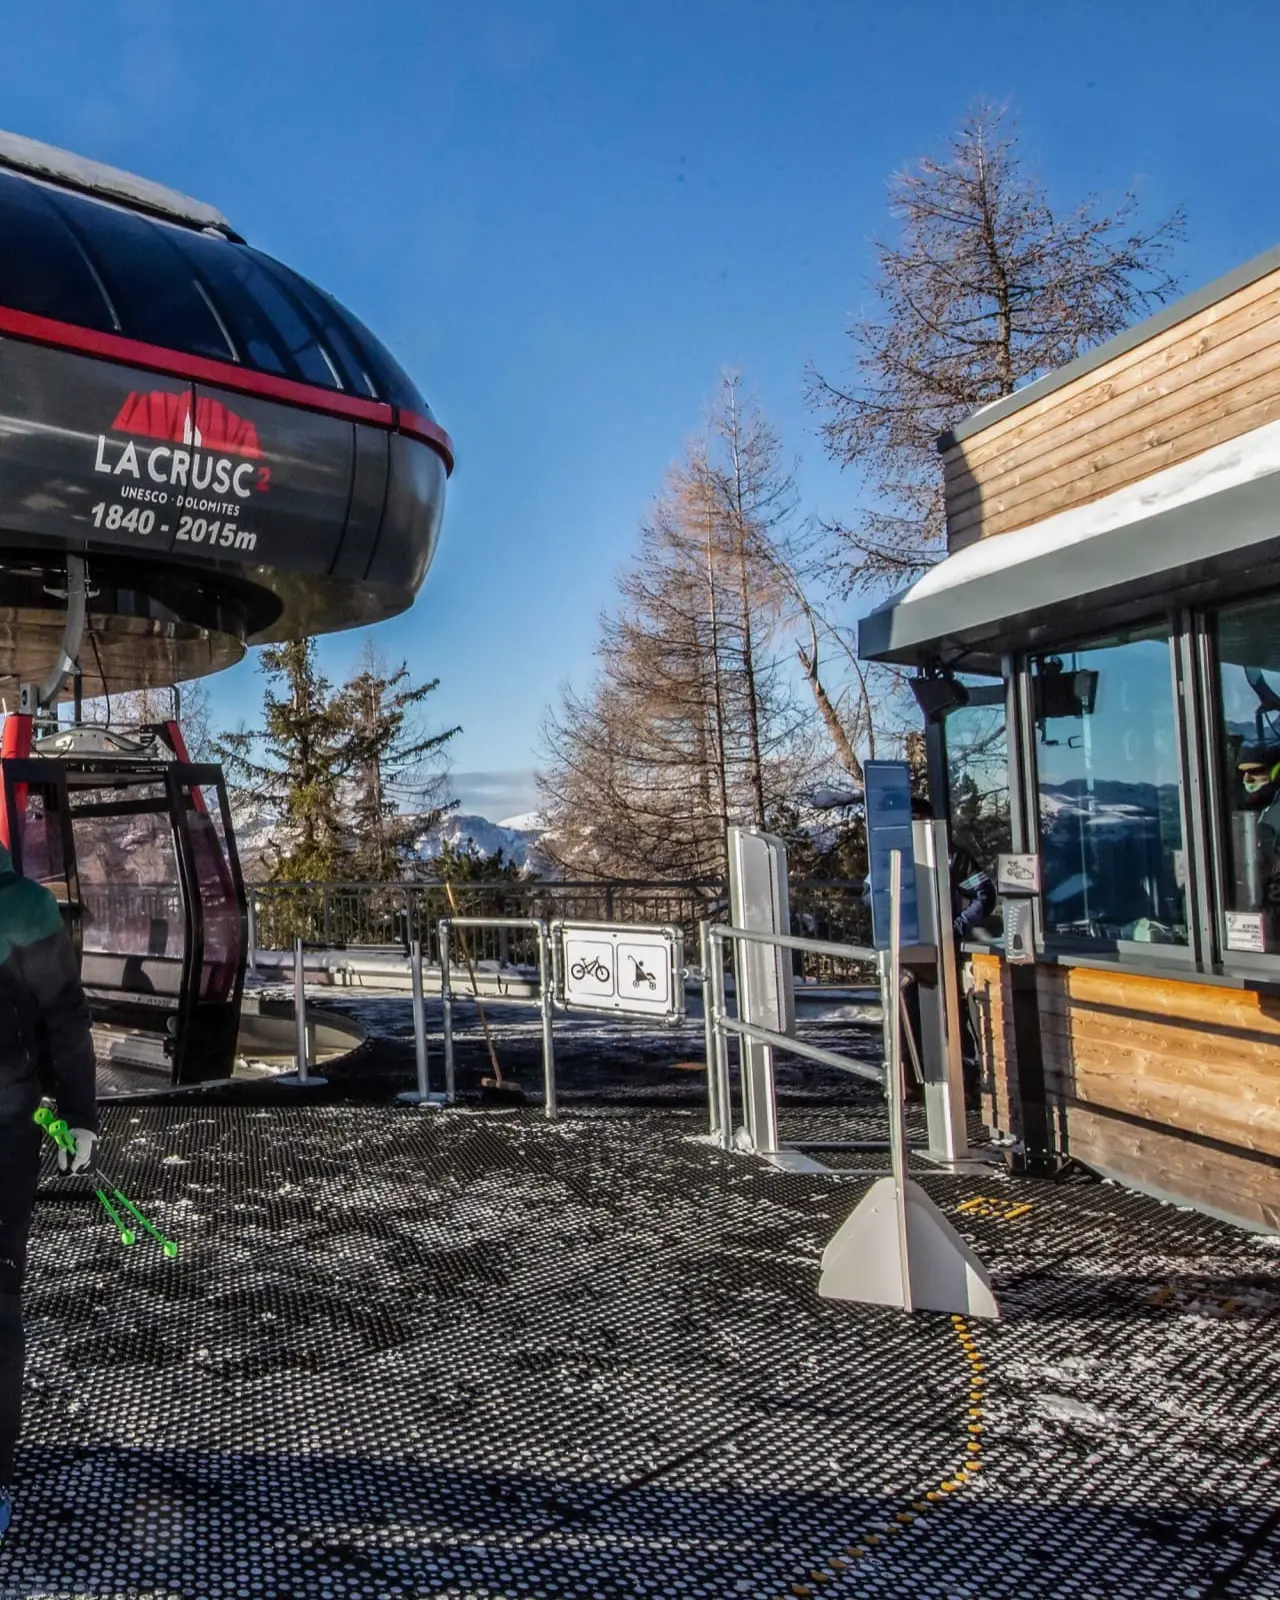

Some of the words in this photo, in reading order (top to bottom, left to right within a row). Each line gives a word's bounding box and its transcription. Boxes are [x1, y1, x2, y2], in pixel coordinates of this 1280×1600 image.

[121, 485, 168, 504] UNESCO
[176, 496, 240, 516] DOLOMITES
[91, 502, 155, 534] 1840
[176, 516, 257, 550] 2015m
